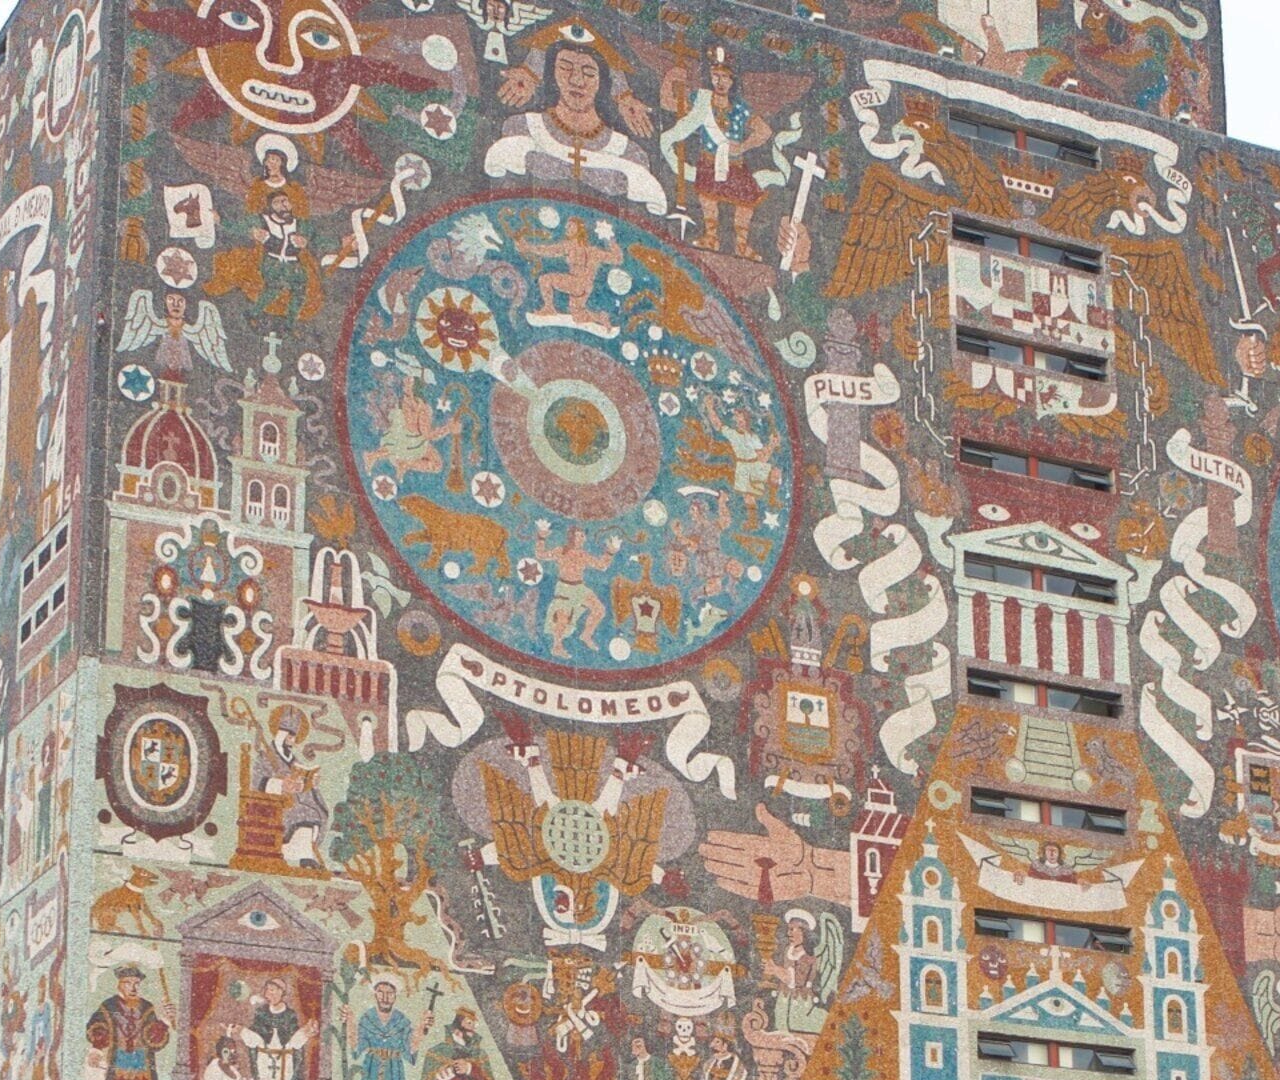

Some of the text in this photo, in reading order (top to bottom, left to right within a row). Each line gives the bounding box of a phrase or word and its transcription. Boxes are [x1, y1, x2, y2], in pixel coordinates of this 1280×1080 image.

[854, 91, 881, 105] 1521
[1167, 168, 1189, 191] 1820
[814, 379, 873, 400] PLUS
[1190, 454, 1245, 489] ULTRA
[491, 673, 663, 717] PTOLOMEO
[673, 925, 695, 934] INRI
